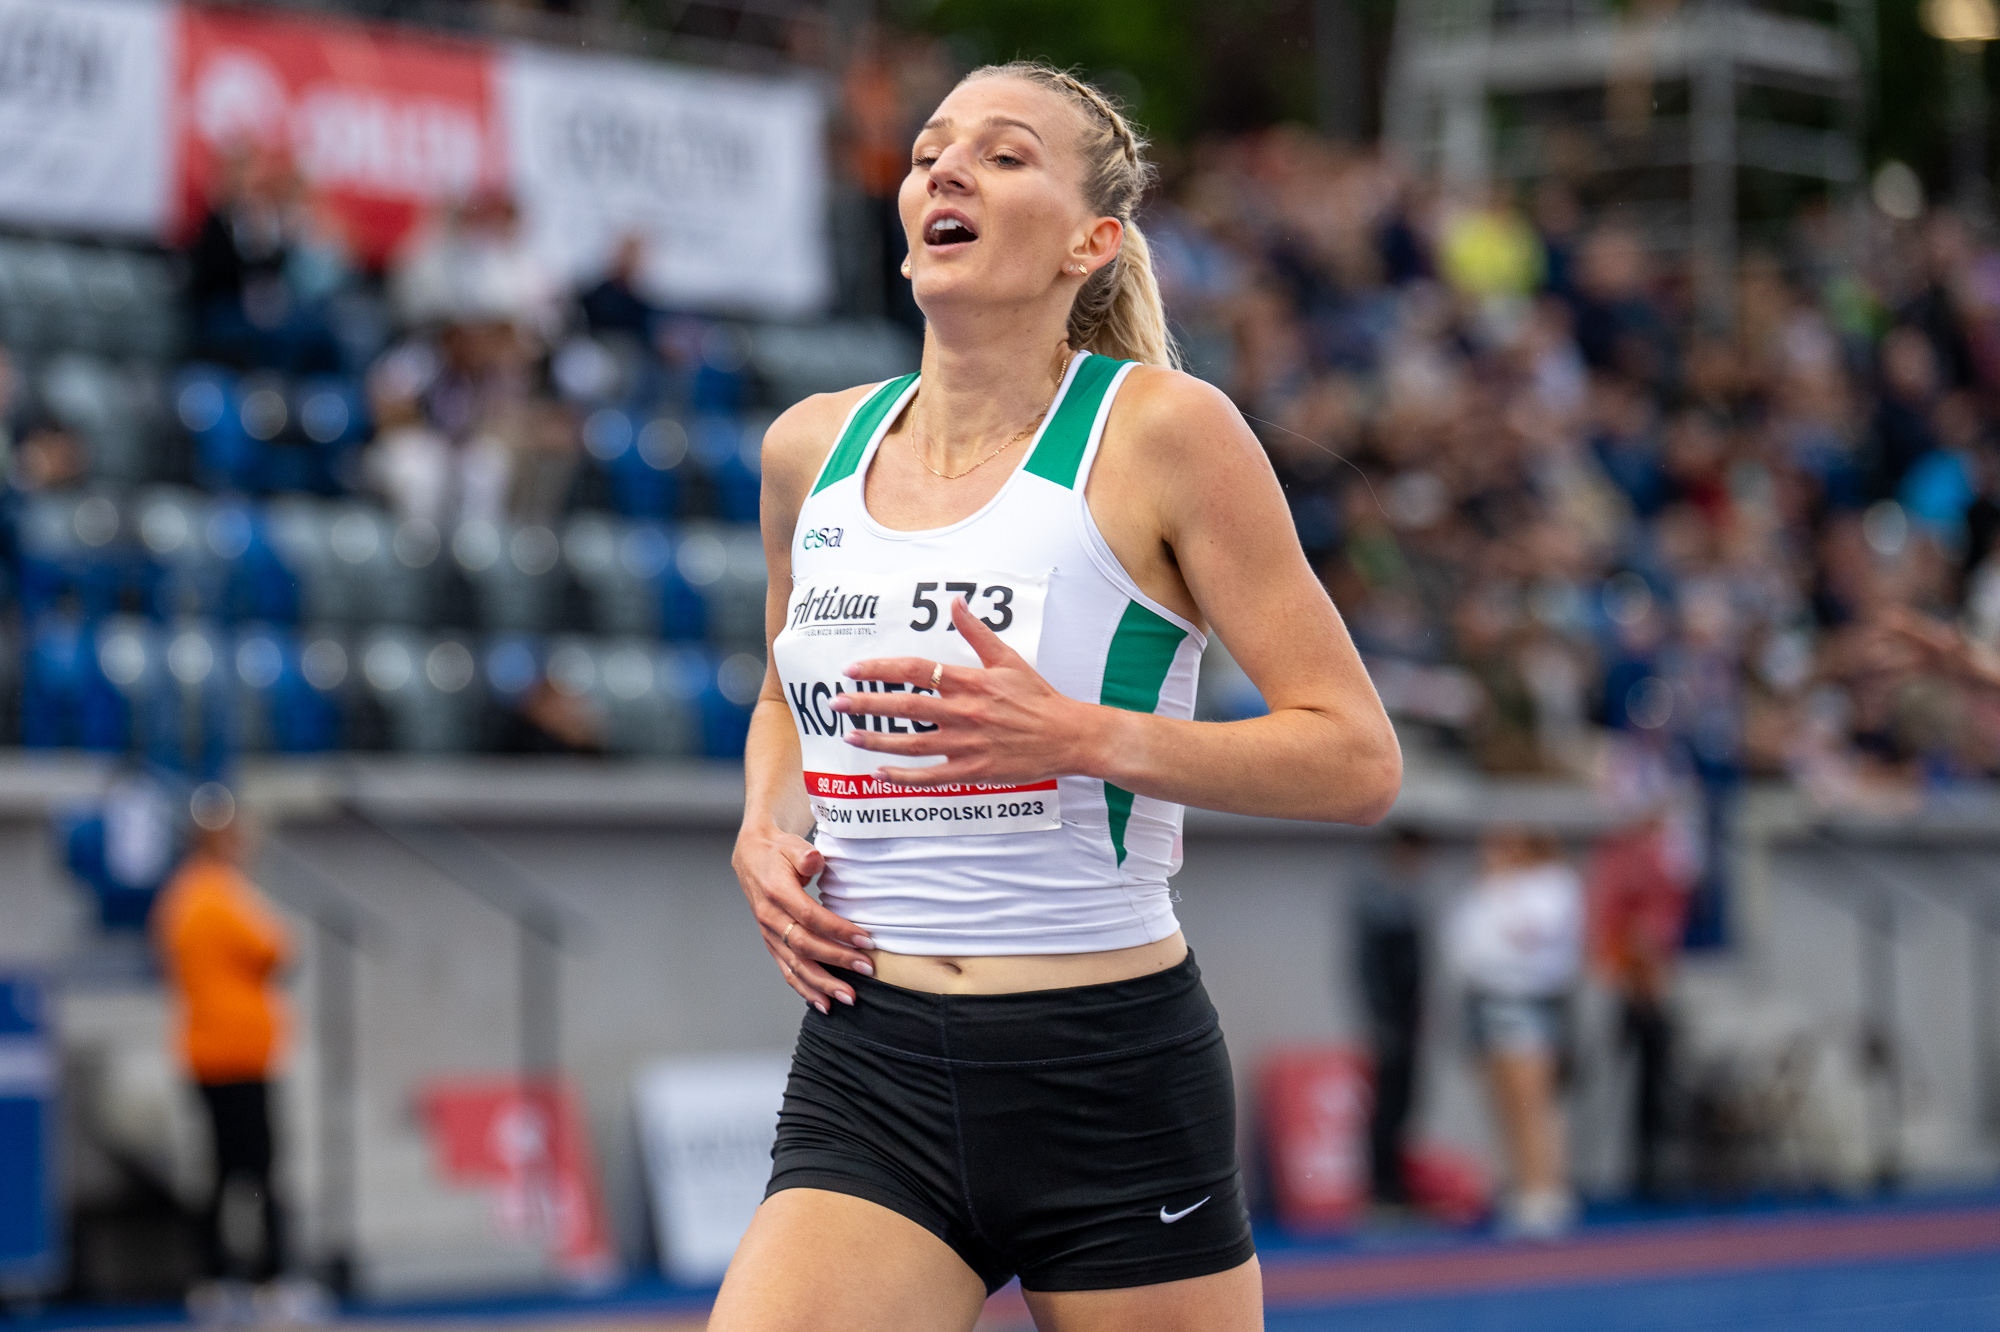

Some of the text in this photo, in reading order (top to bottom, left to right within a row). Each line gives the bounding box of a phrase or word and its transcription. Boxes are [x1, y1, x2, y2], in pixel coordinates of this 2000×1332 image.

[790, 585, 880, 631] Artisan
[909, 581, 1014, 633] 573
[831, 779, 859, 796] PZLA
[856, 804, 993, 824] WIELKOPOLSKI
[997, 801, 1045, 818] 2023
